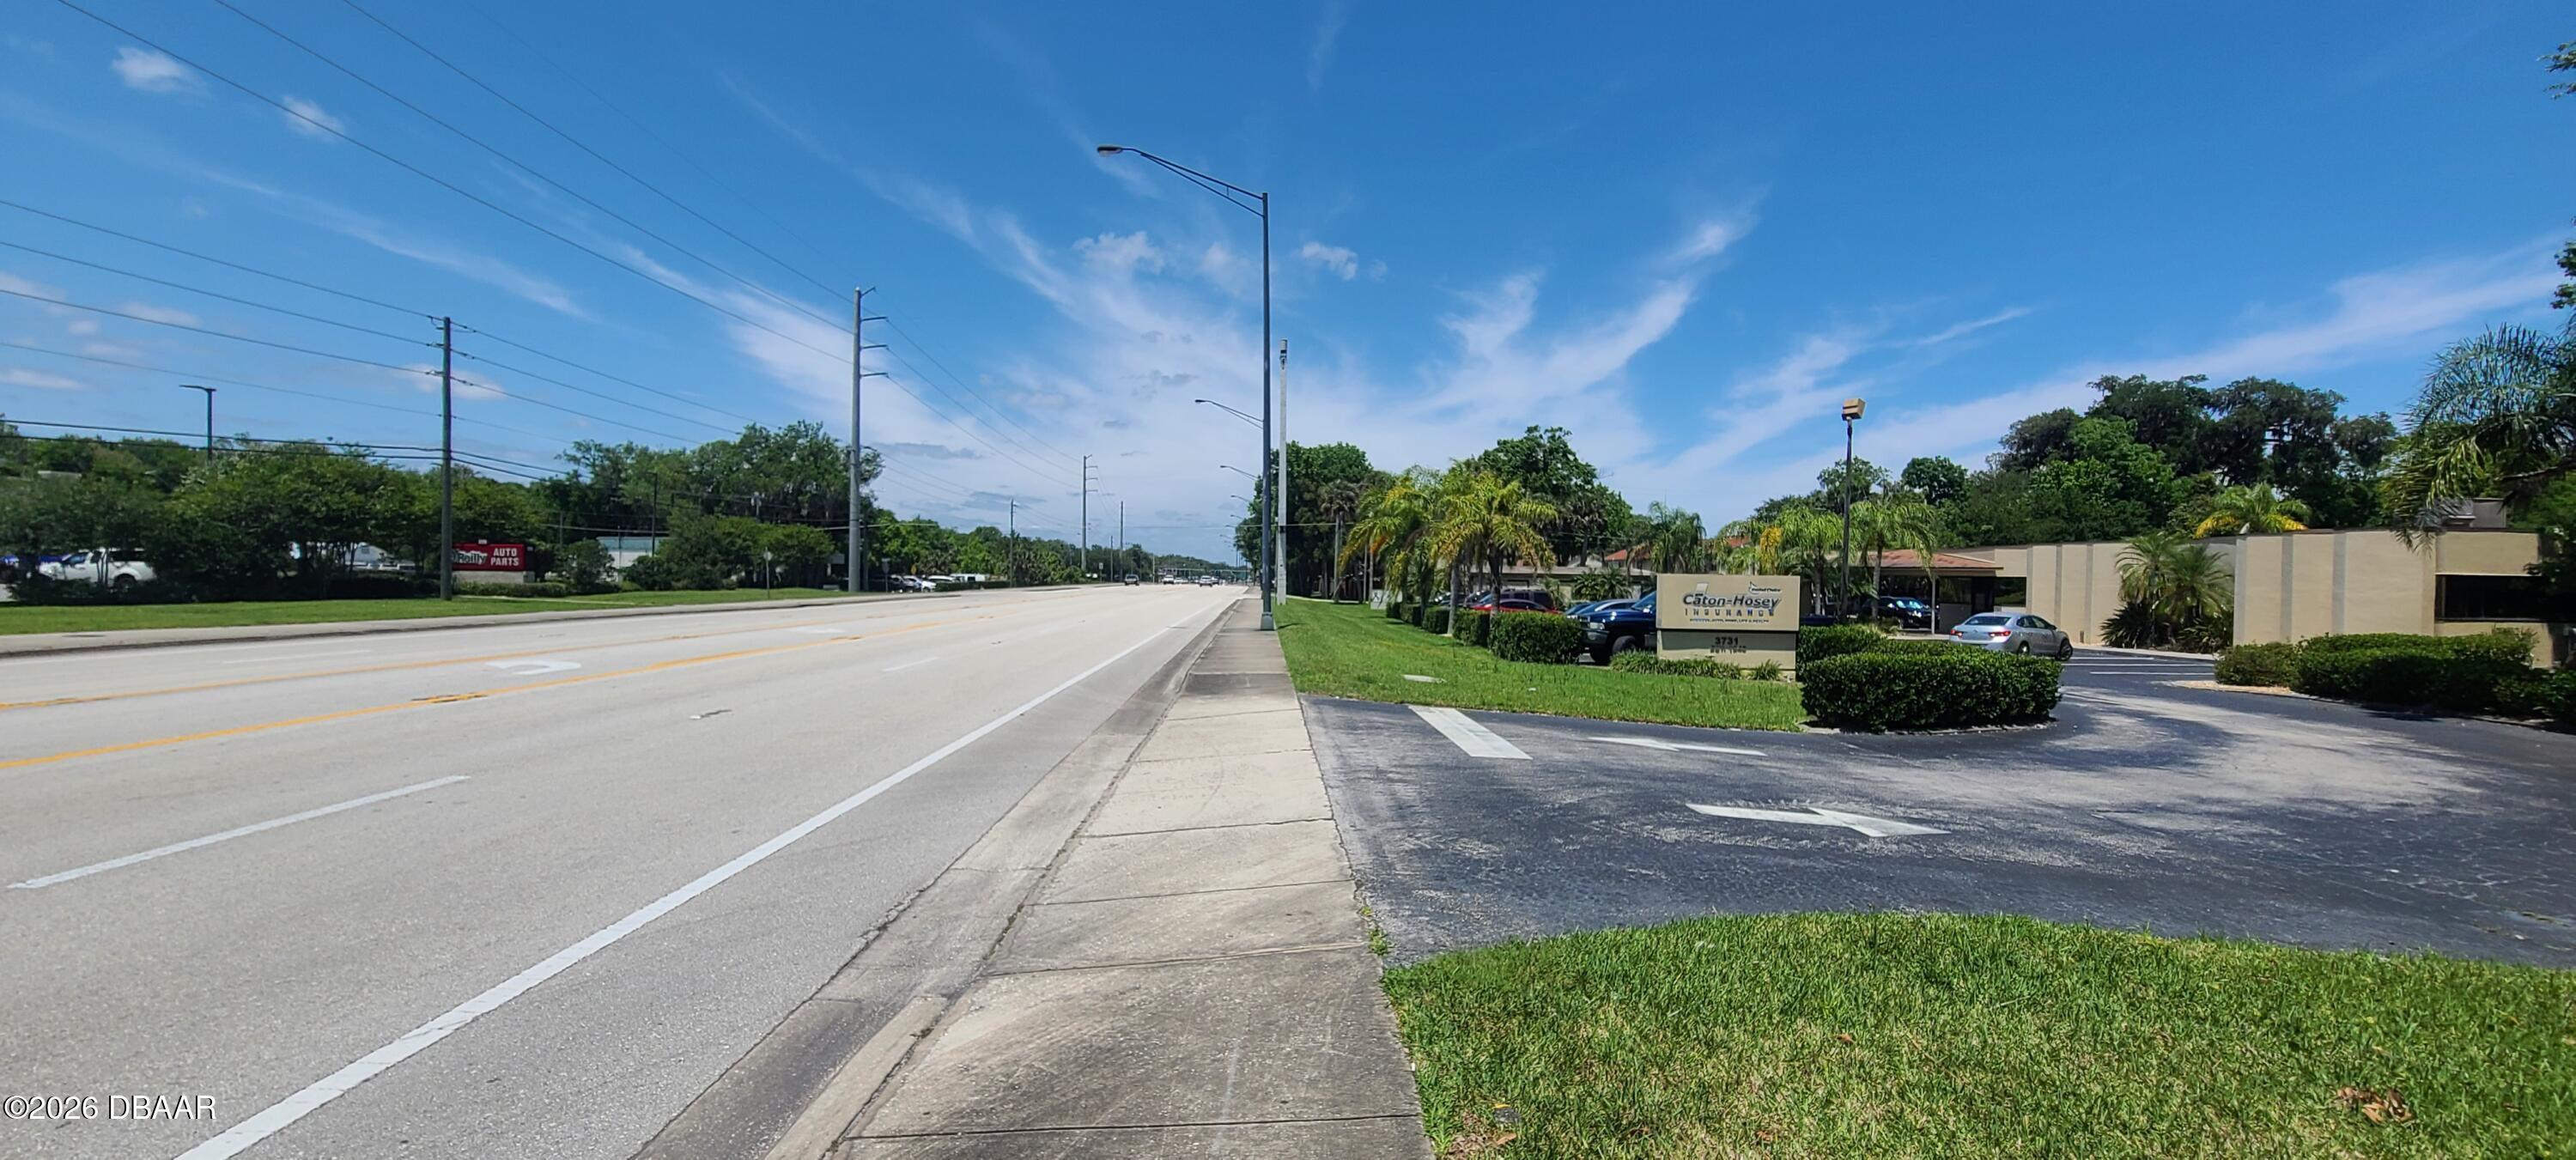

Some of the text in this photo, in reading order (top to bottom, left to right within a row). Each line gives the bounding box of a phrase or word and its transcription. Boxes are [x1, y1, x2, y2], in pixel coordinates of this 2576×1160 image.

[493, 548, 517, 556] AUTO
[490, 557, 519, 566] PARTS
[1683, 594, 1780, 610] Caton-Hosey
[1715, 636, 1739, 646] 3731
